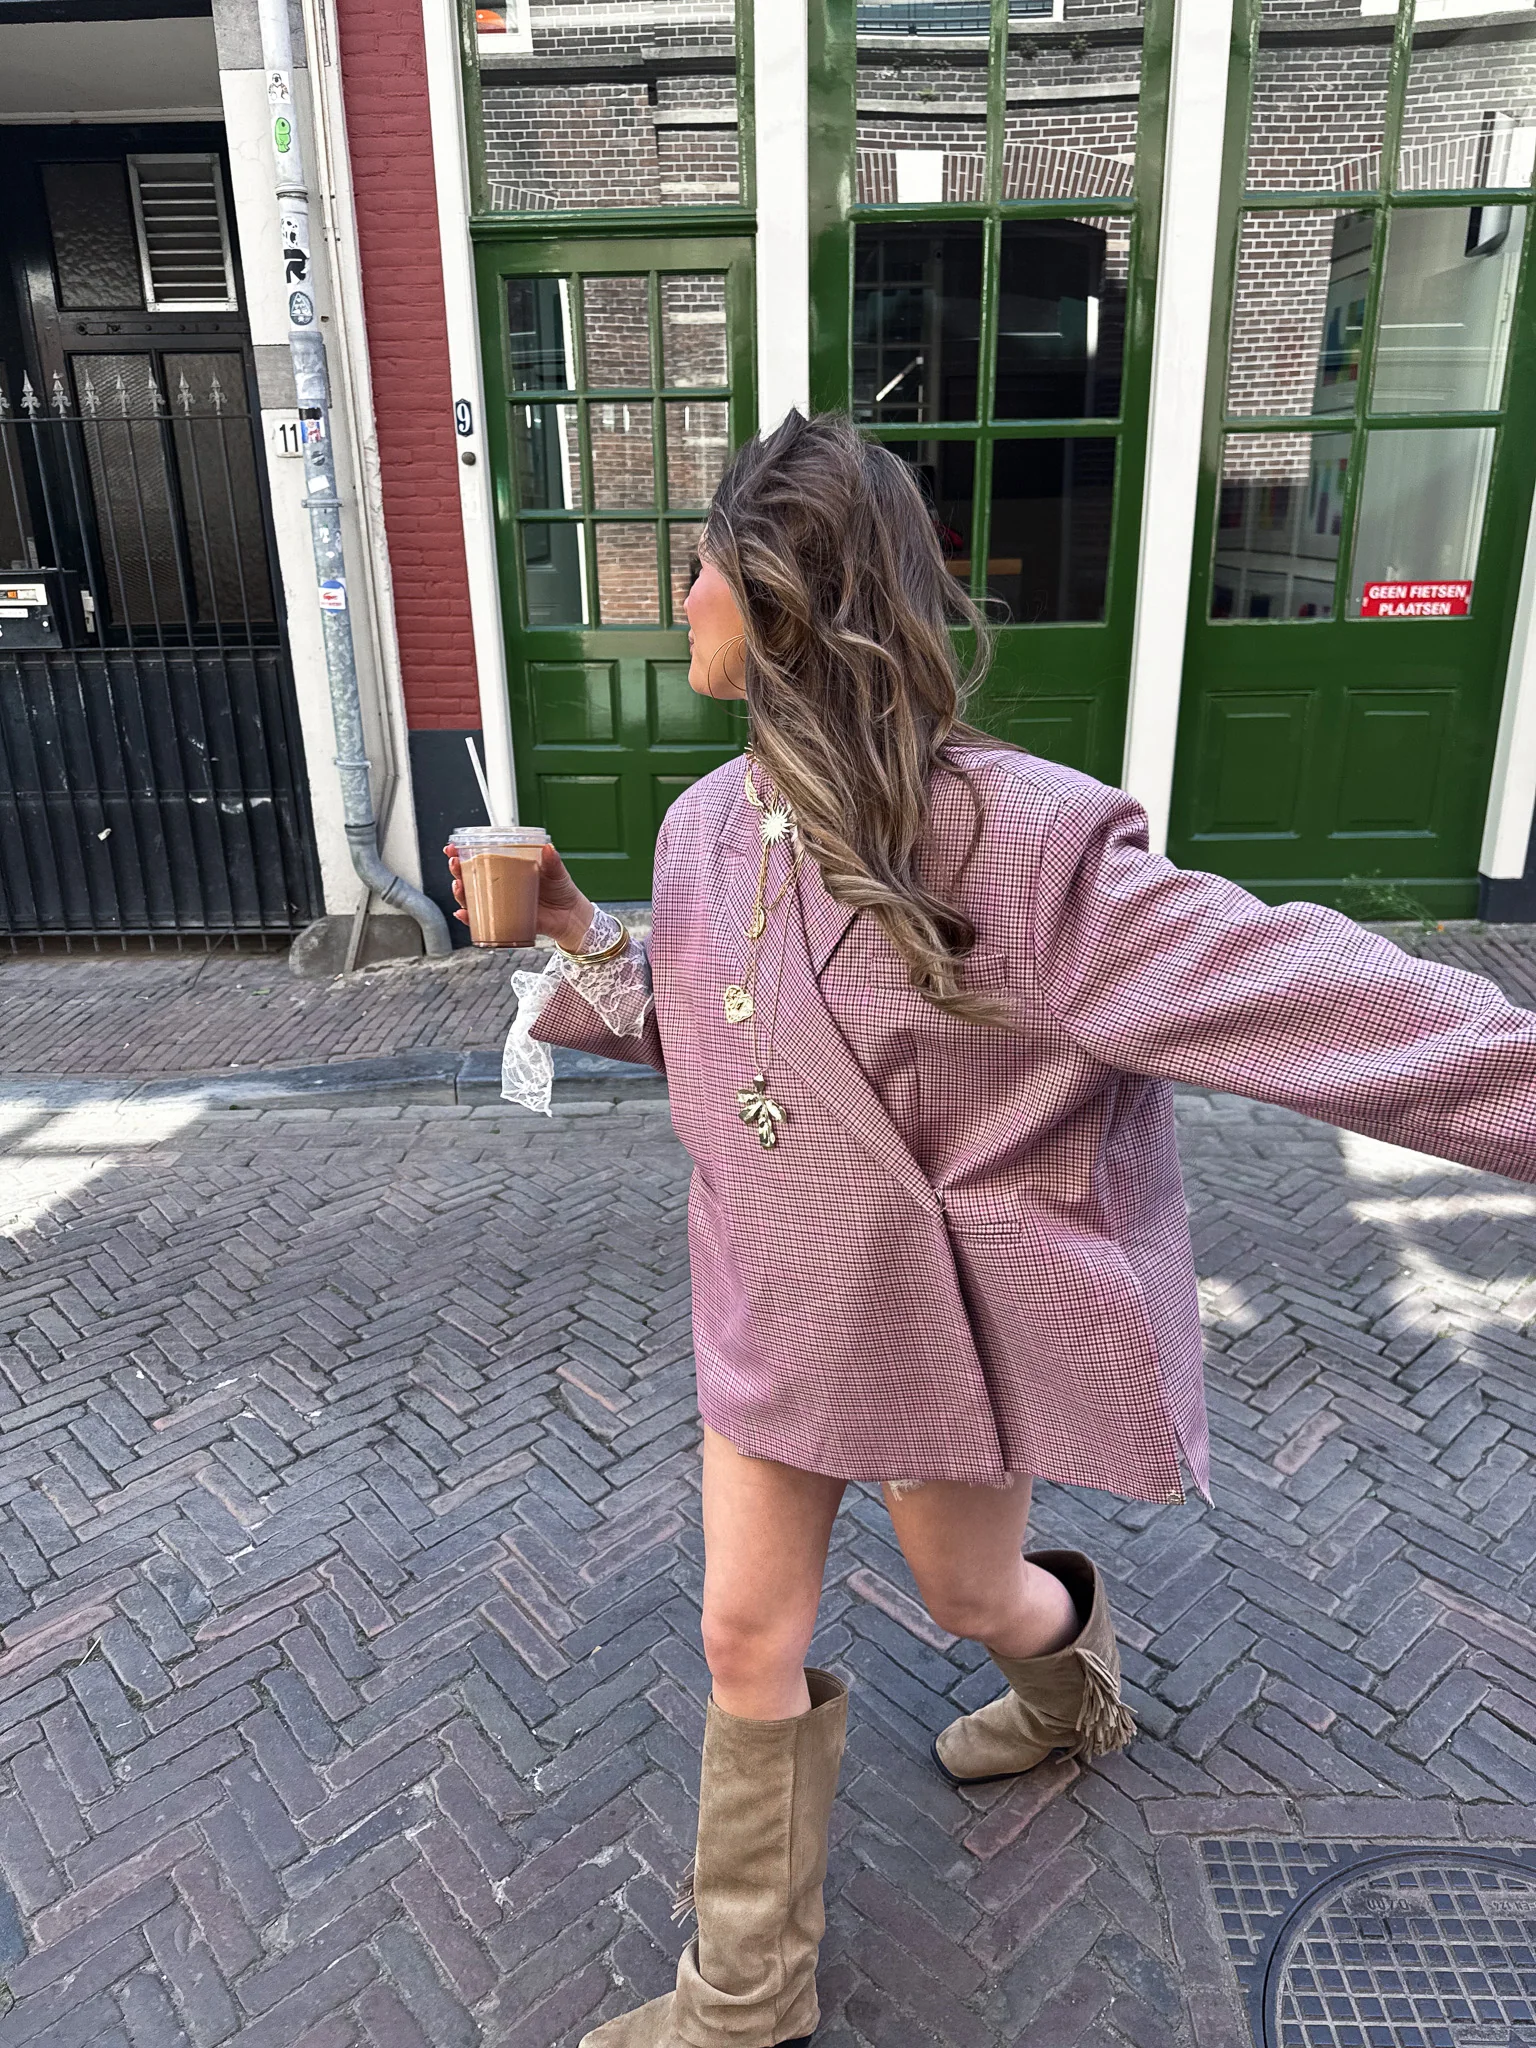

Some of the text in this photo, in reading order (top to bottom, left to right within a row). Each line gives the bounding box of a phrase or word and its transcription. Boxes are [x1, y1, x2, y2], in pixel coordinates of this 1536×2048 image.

[457, 403, 470, 433] 9
[279, 424, 299, 452] 11
[1368, 584, 1468, 599] GEEN FIETSEN
[1378, 602, 1452, 616] PLAATSEN
